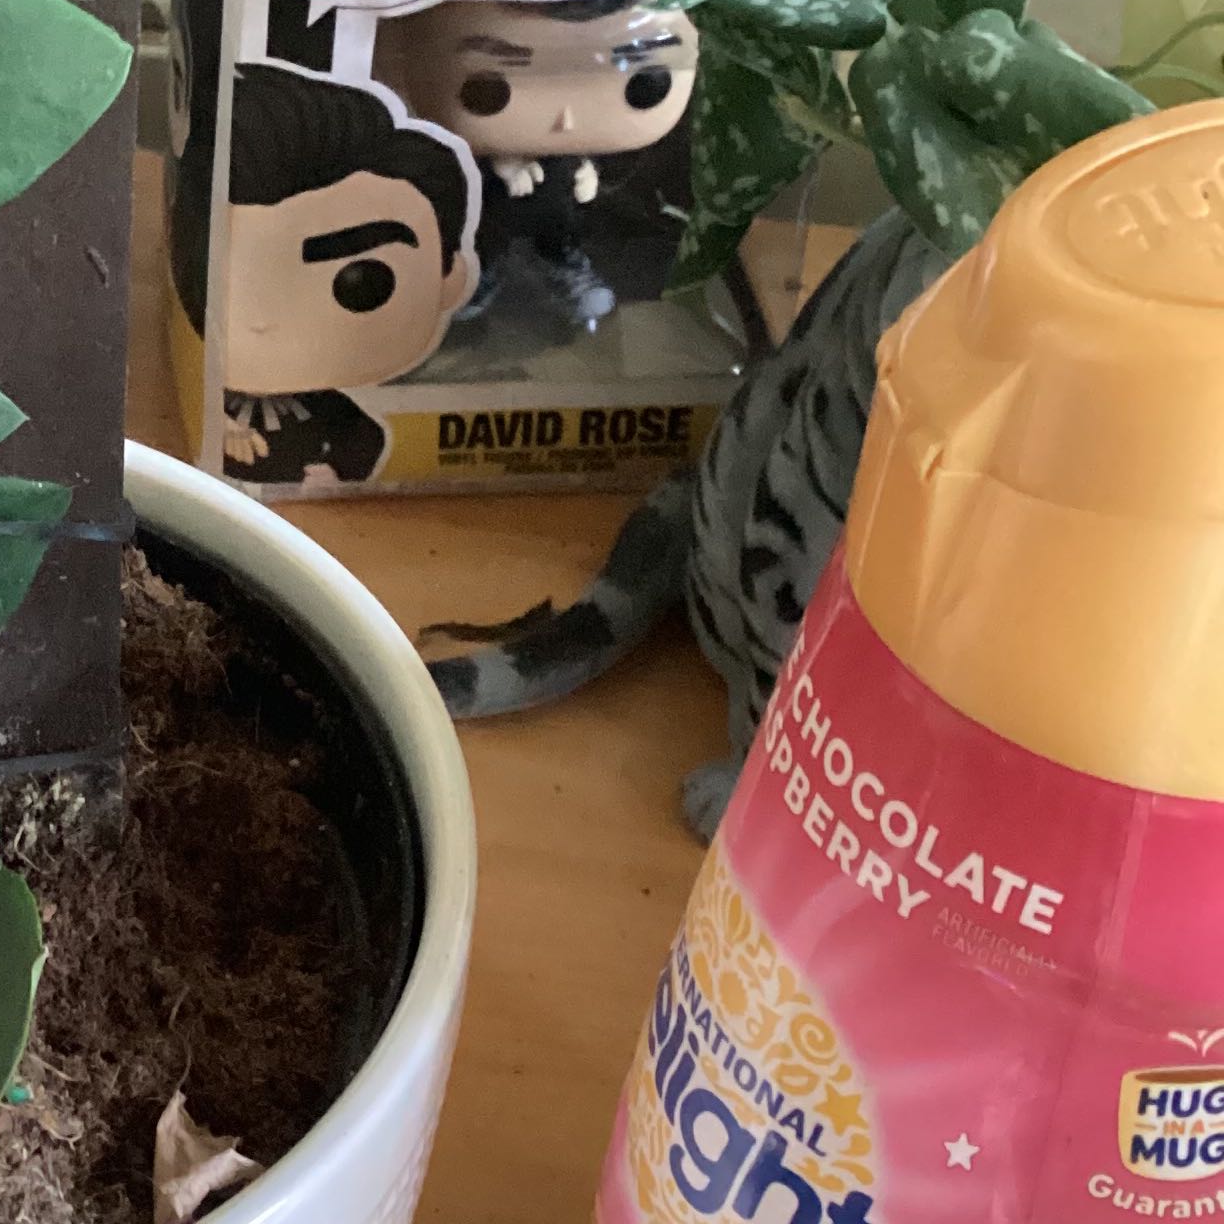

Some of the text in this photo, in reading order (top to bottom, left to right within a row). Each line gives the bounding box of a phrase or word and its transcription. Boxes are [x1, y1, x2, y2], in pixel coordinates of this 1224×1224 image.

[438, 405, 694, 449] DAVID ROSE
[791, 672, 1065, 935] CHOCOLATE
[1137, 1086, 1224, 1118] HUG
[1163, 1119, 1205, 1136] IN A
[1130, 1133, 1224, 1168] MUG
